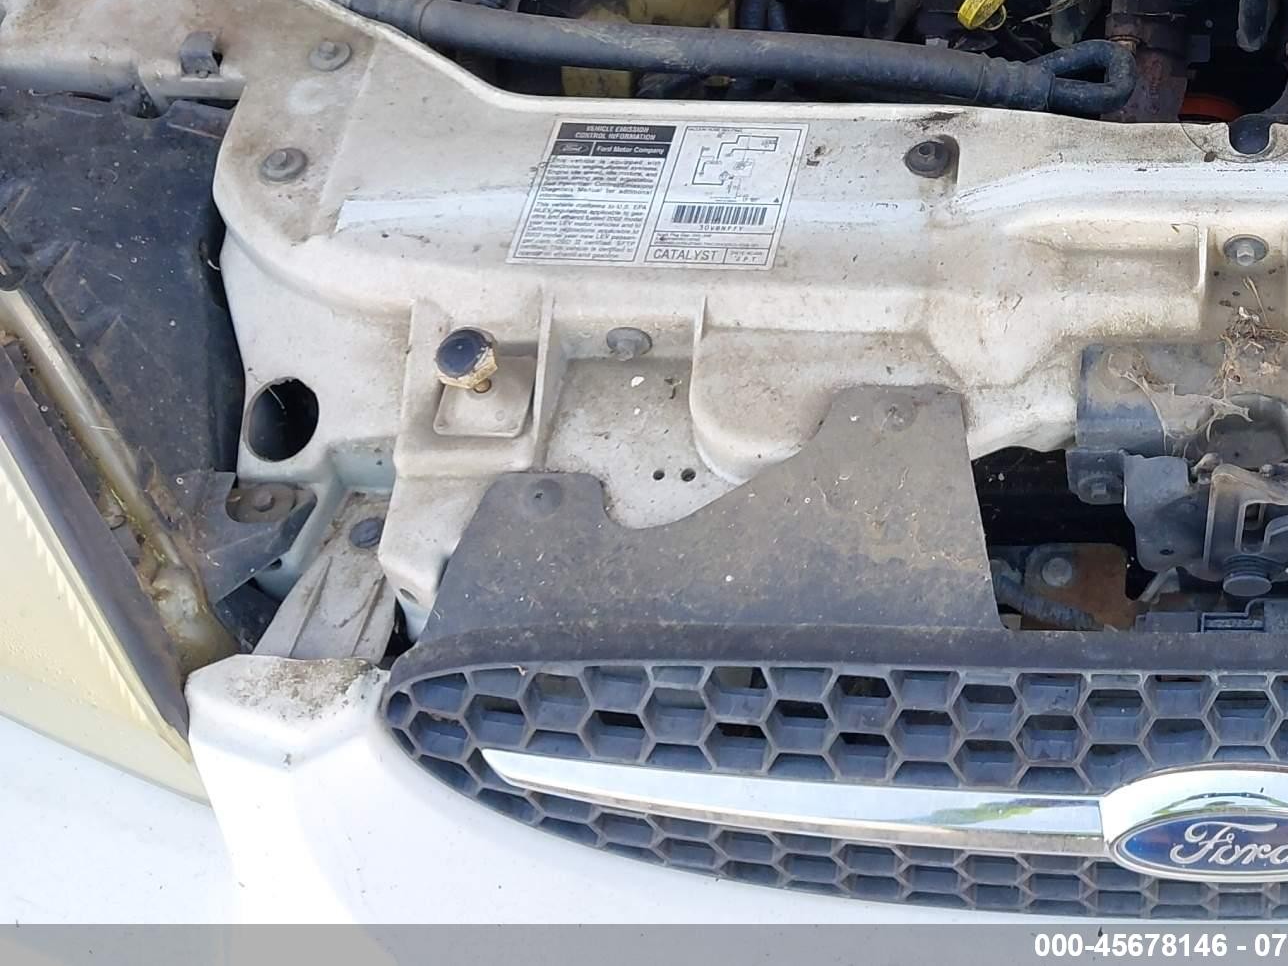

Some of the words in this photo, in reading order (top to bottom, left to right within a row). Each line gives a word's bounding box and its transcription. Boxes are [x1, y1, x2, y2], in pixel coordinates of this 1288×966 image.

[608, 132, 656, 140] INFORMATION
[634, 146, 665, 155] Company
[654, 248, 718, 261] CATALYST
